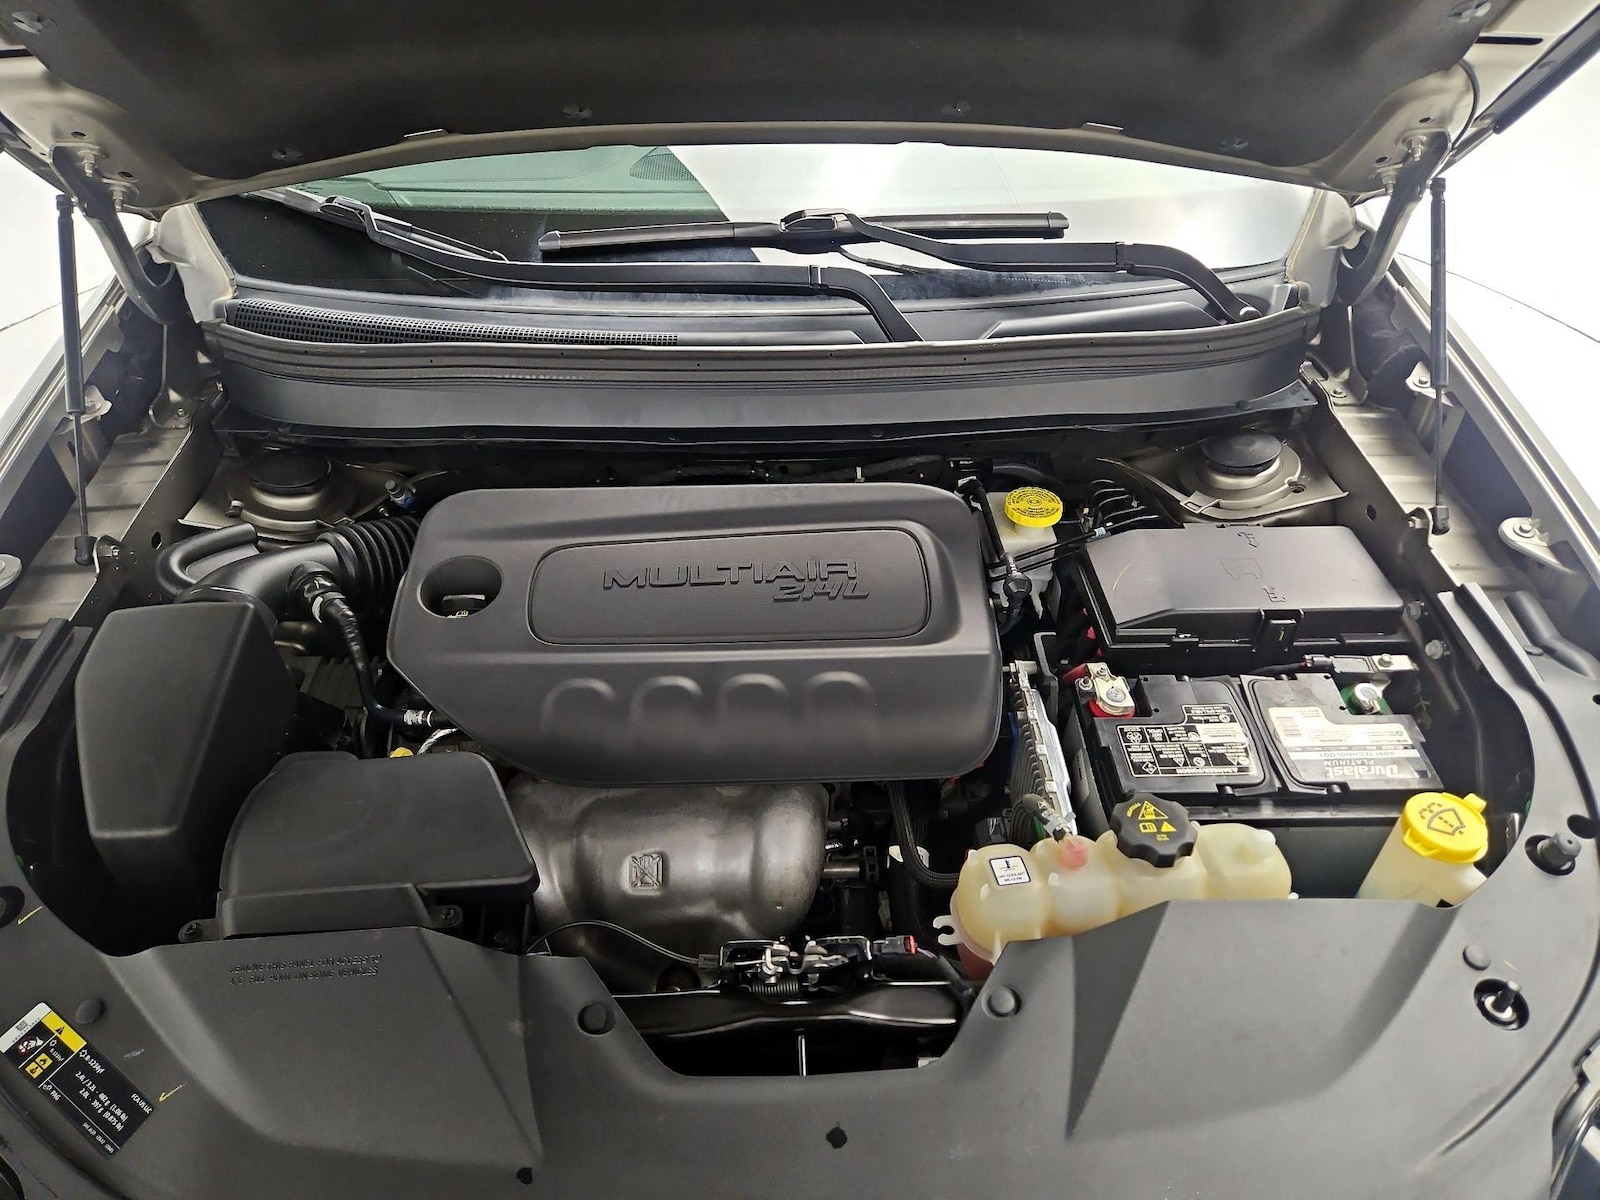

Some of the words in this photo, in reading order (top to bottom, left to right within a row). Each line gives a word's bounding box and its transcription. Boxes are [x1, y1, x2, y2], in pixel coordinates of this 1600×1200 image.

[603, 559, 858, 590] MULTIAIR
[772, 580, 870, 602] 2.4L
[1323, 759, 1375, 767] PLATINUM
[1325, 763, 1399, 778] Duralast
[267, 961, 287, 971] THIS
[287, 959, 314, 970] PANEL
[317, 957, 335, 967] FOR
[336, 955, 369, 966] ACCESS
[337, 966, 379, 978] VEHICLES
[50, 1089, 62, 1101] PAG
